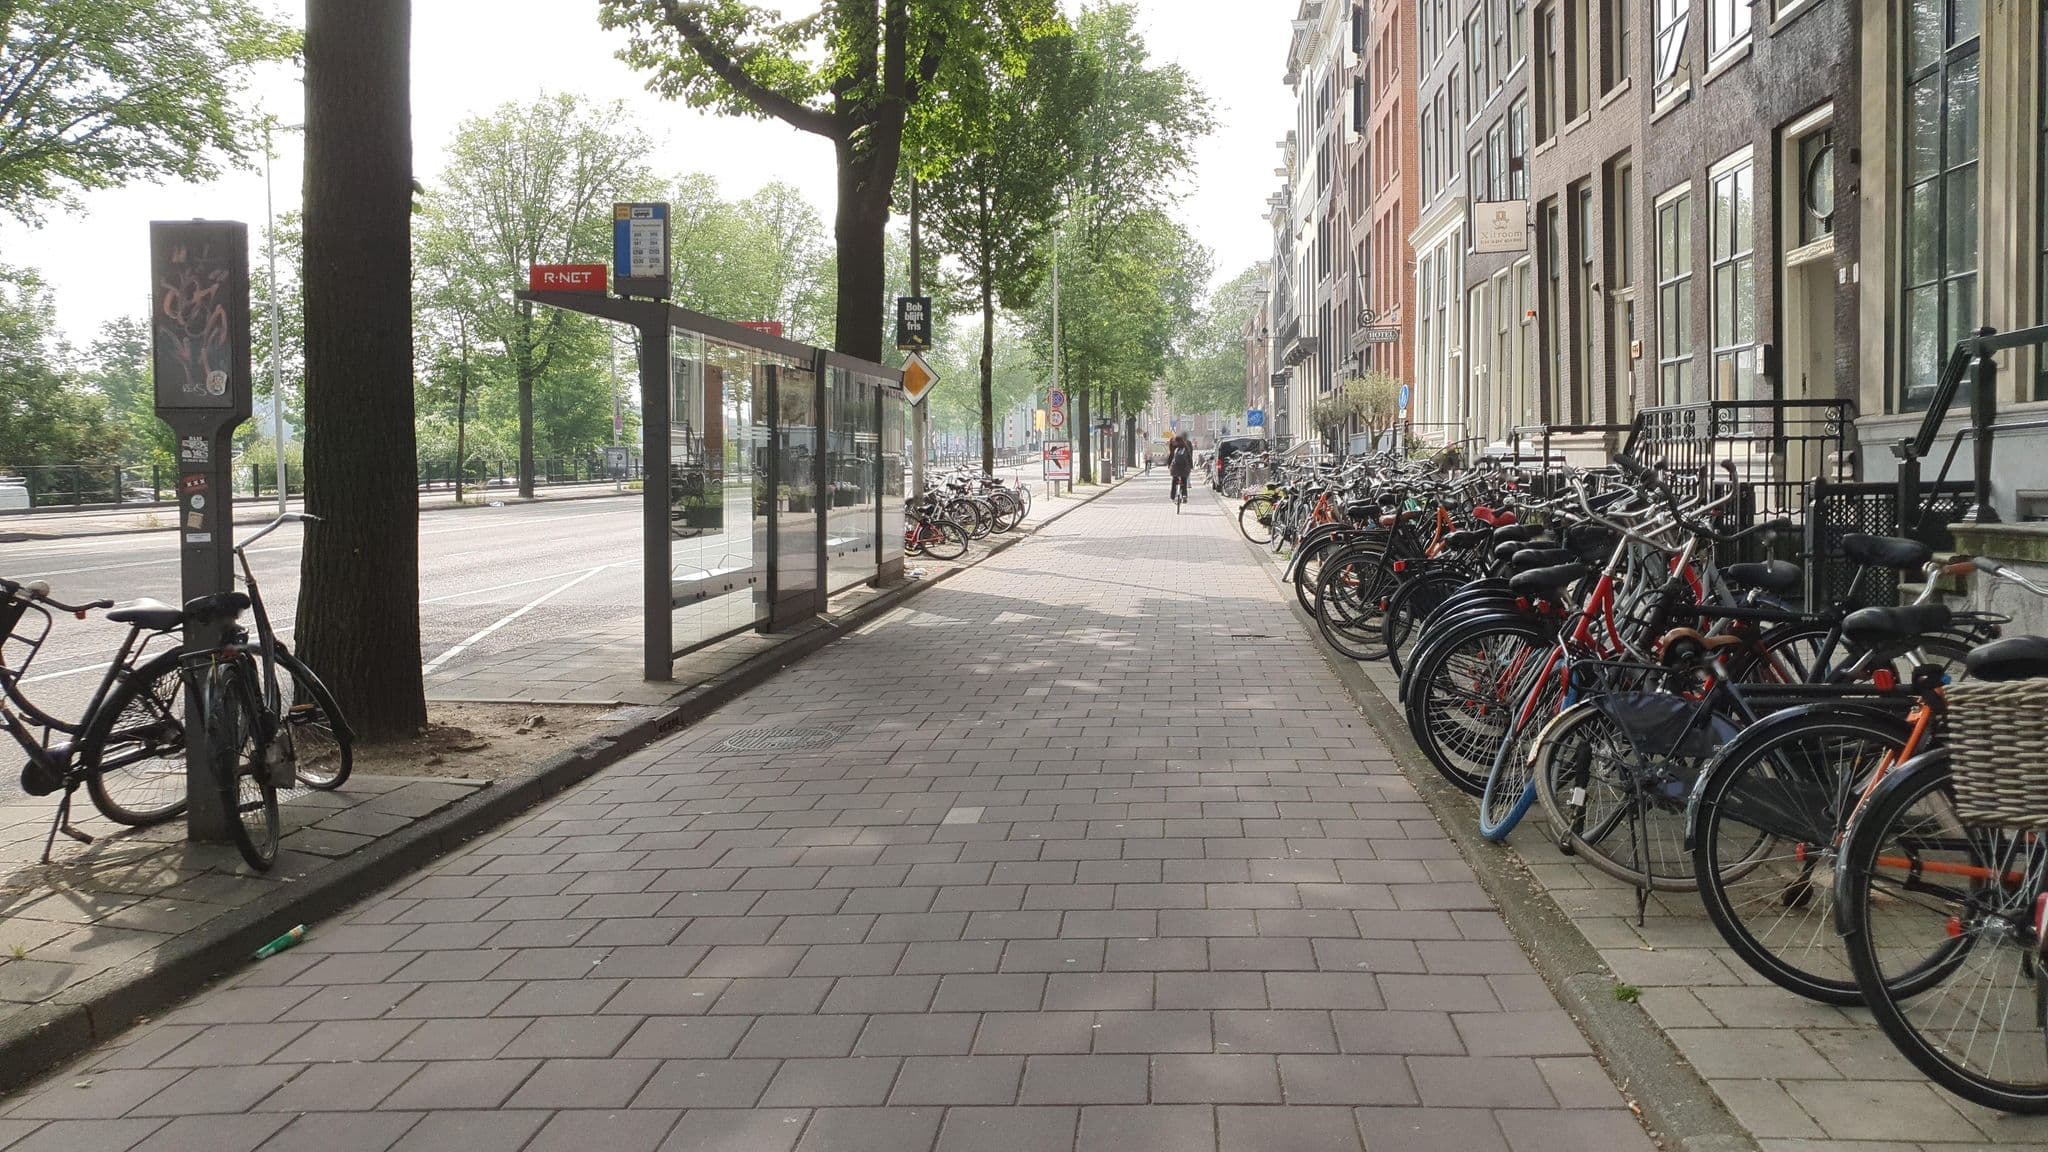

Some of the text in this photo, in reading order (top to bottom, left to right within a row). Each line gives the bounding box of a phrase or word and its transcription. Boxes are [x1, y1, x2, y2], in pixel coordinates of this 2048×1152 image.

[906, 302, 923, 312] Bob
[904, 311, 924, 323] blijft
[907, 321, 922, 331] fris
